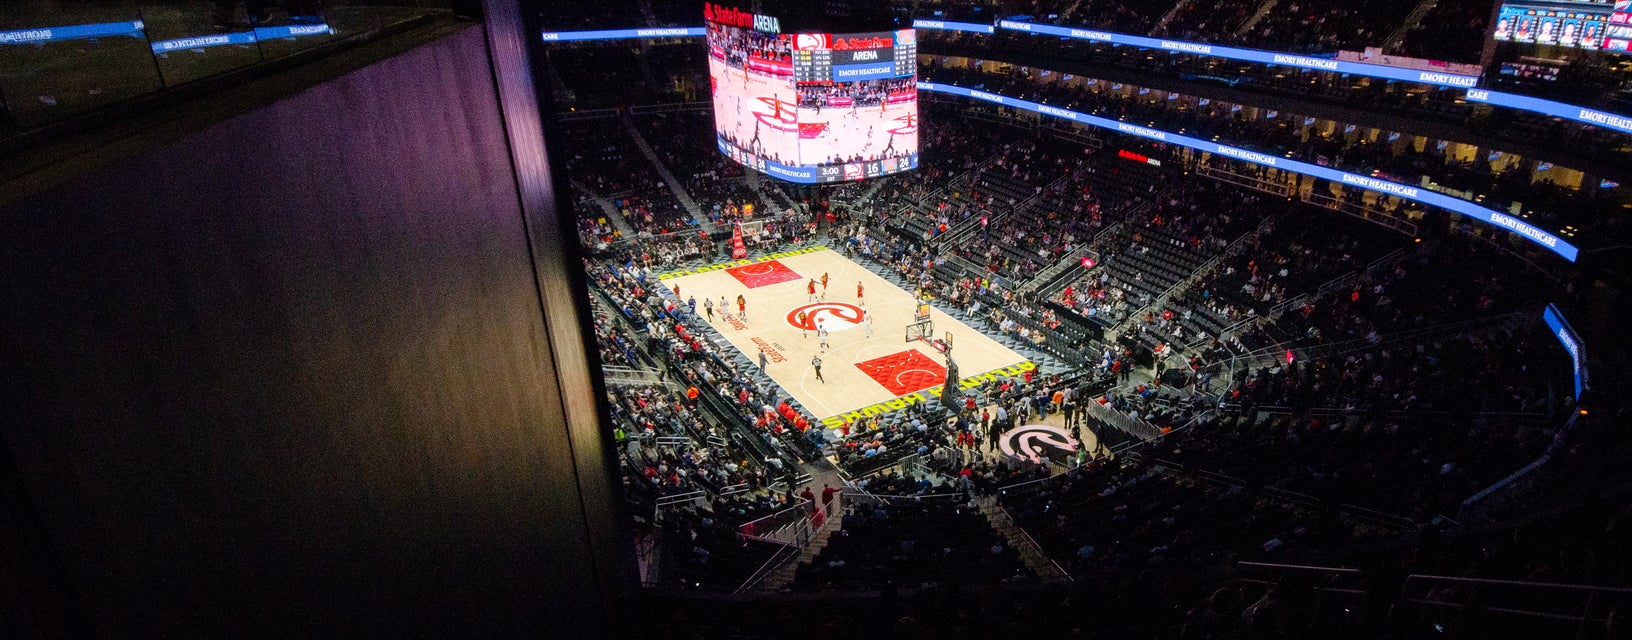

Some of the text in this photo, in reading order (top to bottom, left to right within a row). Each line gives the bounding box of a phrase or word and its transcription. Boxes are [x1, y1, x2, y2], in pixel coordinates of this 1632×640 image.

[754, 14, 780, 34] ARENA
[1178, 44, 1210, 52] HEALTHCARE
[853, 50, 878, 61] ARENA
[1274, 54, 1338, 69] EMORY HEALTHCARE
[858, 66, 890, 75] HEALTHCARE
[1420, 72, 1449, 83] EMORY
[1468, 90, 1488, 100] CARE
[1580, 110, 1608, 124] EMORY
[1119, 124, 1165, 139] EMORY HEALTHCARE
[1218, 146, 1276, 164] EMORY HEALTHCARE
[758, 158, 765, 169] 24
[900, 157, 909, 168] 24
[822, 167, 839, 176] 3:00
[867, 163, 878, 174] 16
[1343, 174, 1417, 197] EMORY HEALTHCARE
[1491, 213, 1556, 248] EMORY HEALTHCARE
[822, 362, 1035, 429] ATLANA HAWKS
